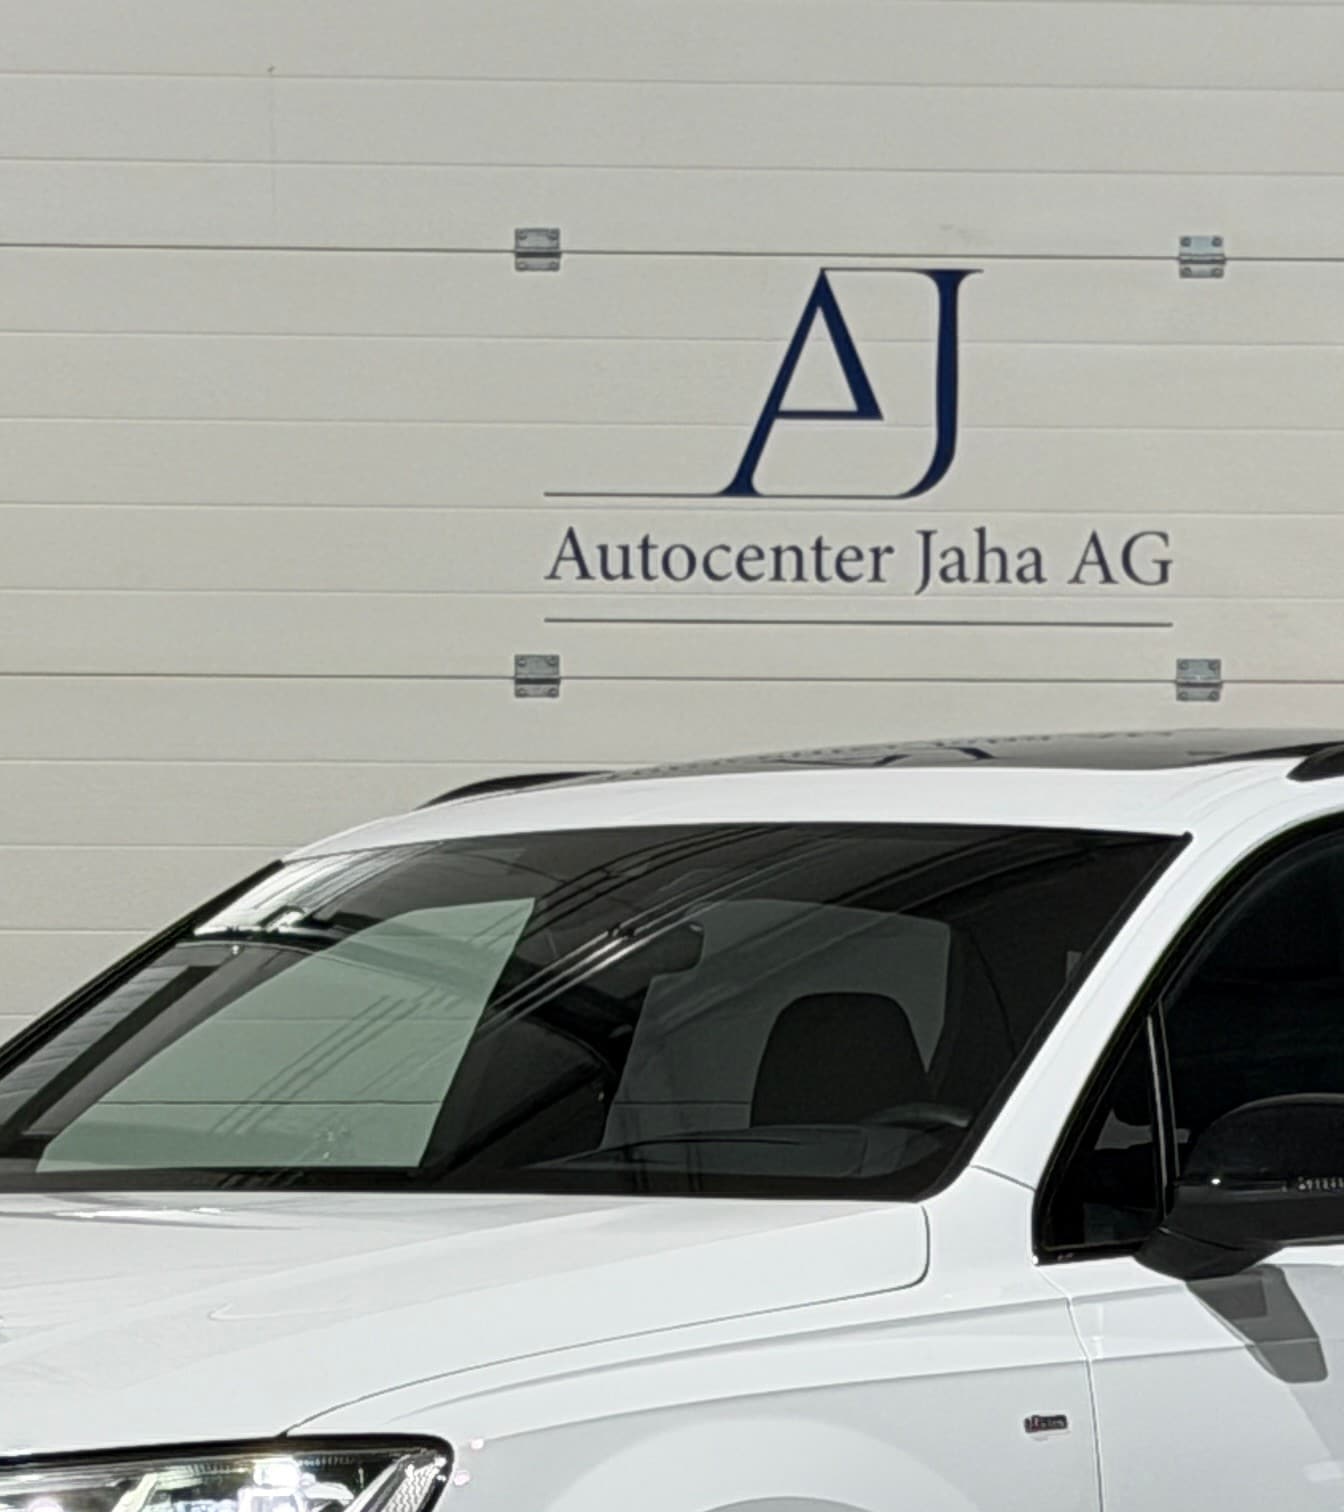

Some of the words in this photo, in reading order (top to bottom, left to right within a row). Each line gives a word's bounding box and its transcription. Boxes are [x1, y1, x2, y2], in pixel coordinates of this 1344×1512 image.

[714, 266, 984, 499] AJ
[543, 526, 895, 583] Autocenter
[914, 526, 1047, 595] Jaha
[1067, 530, 1173, 586] AG
